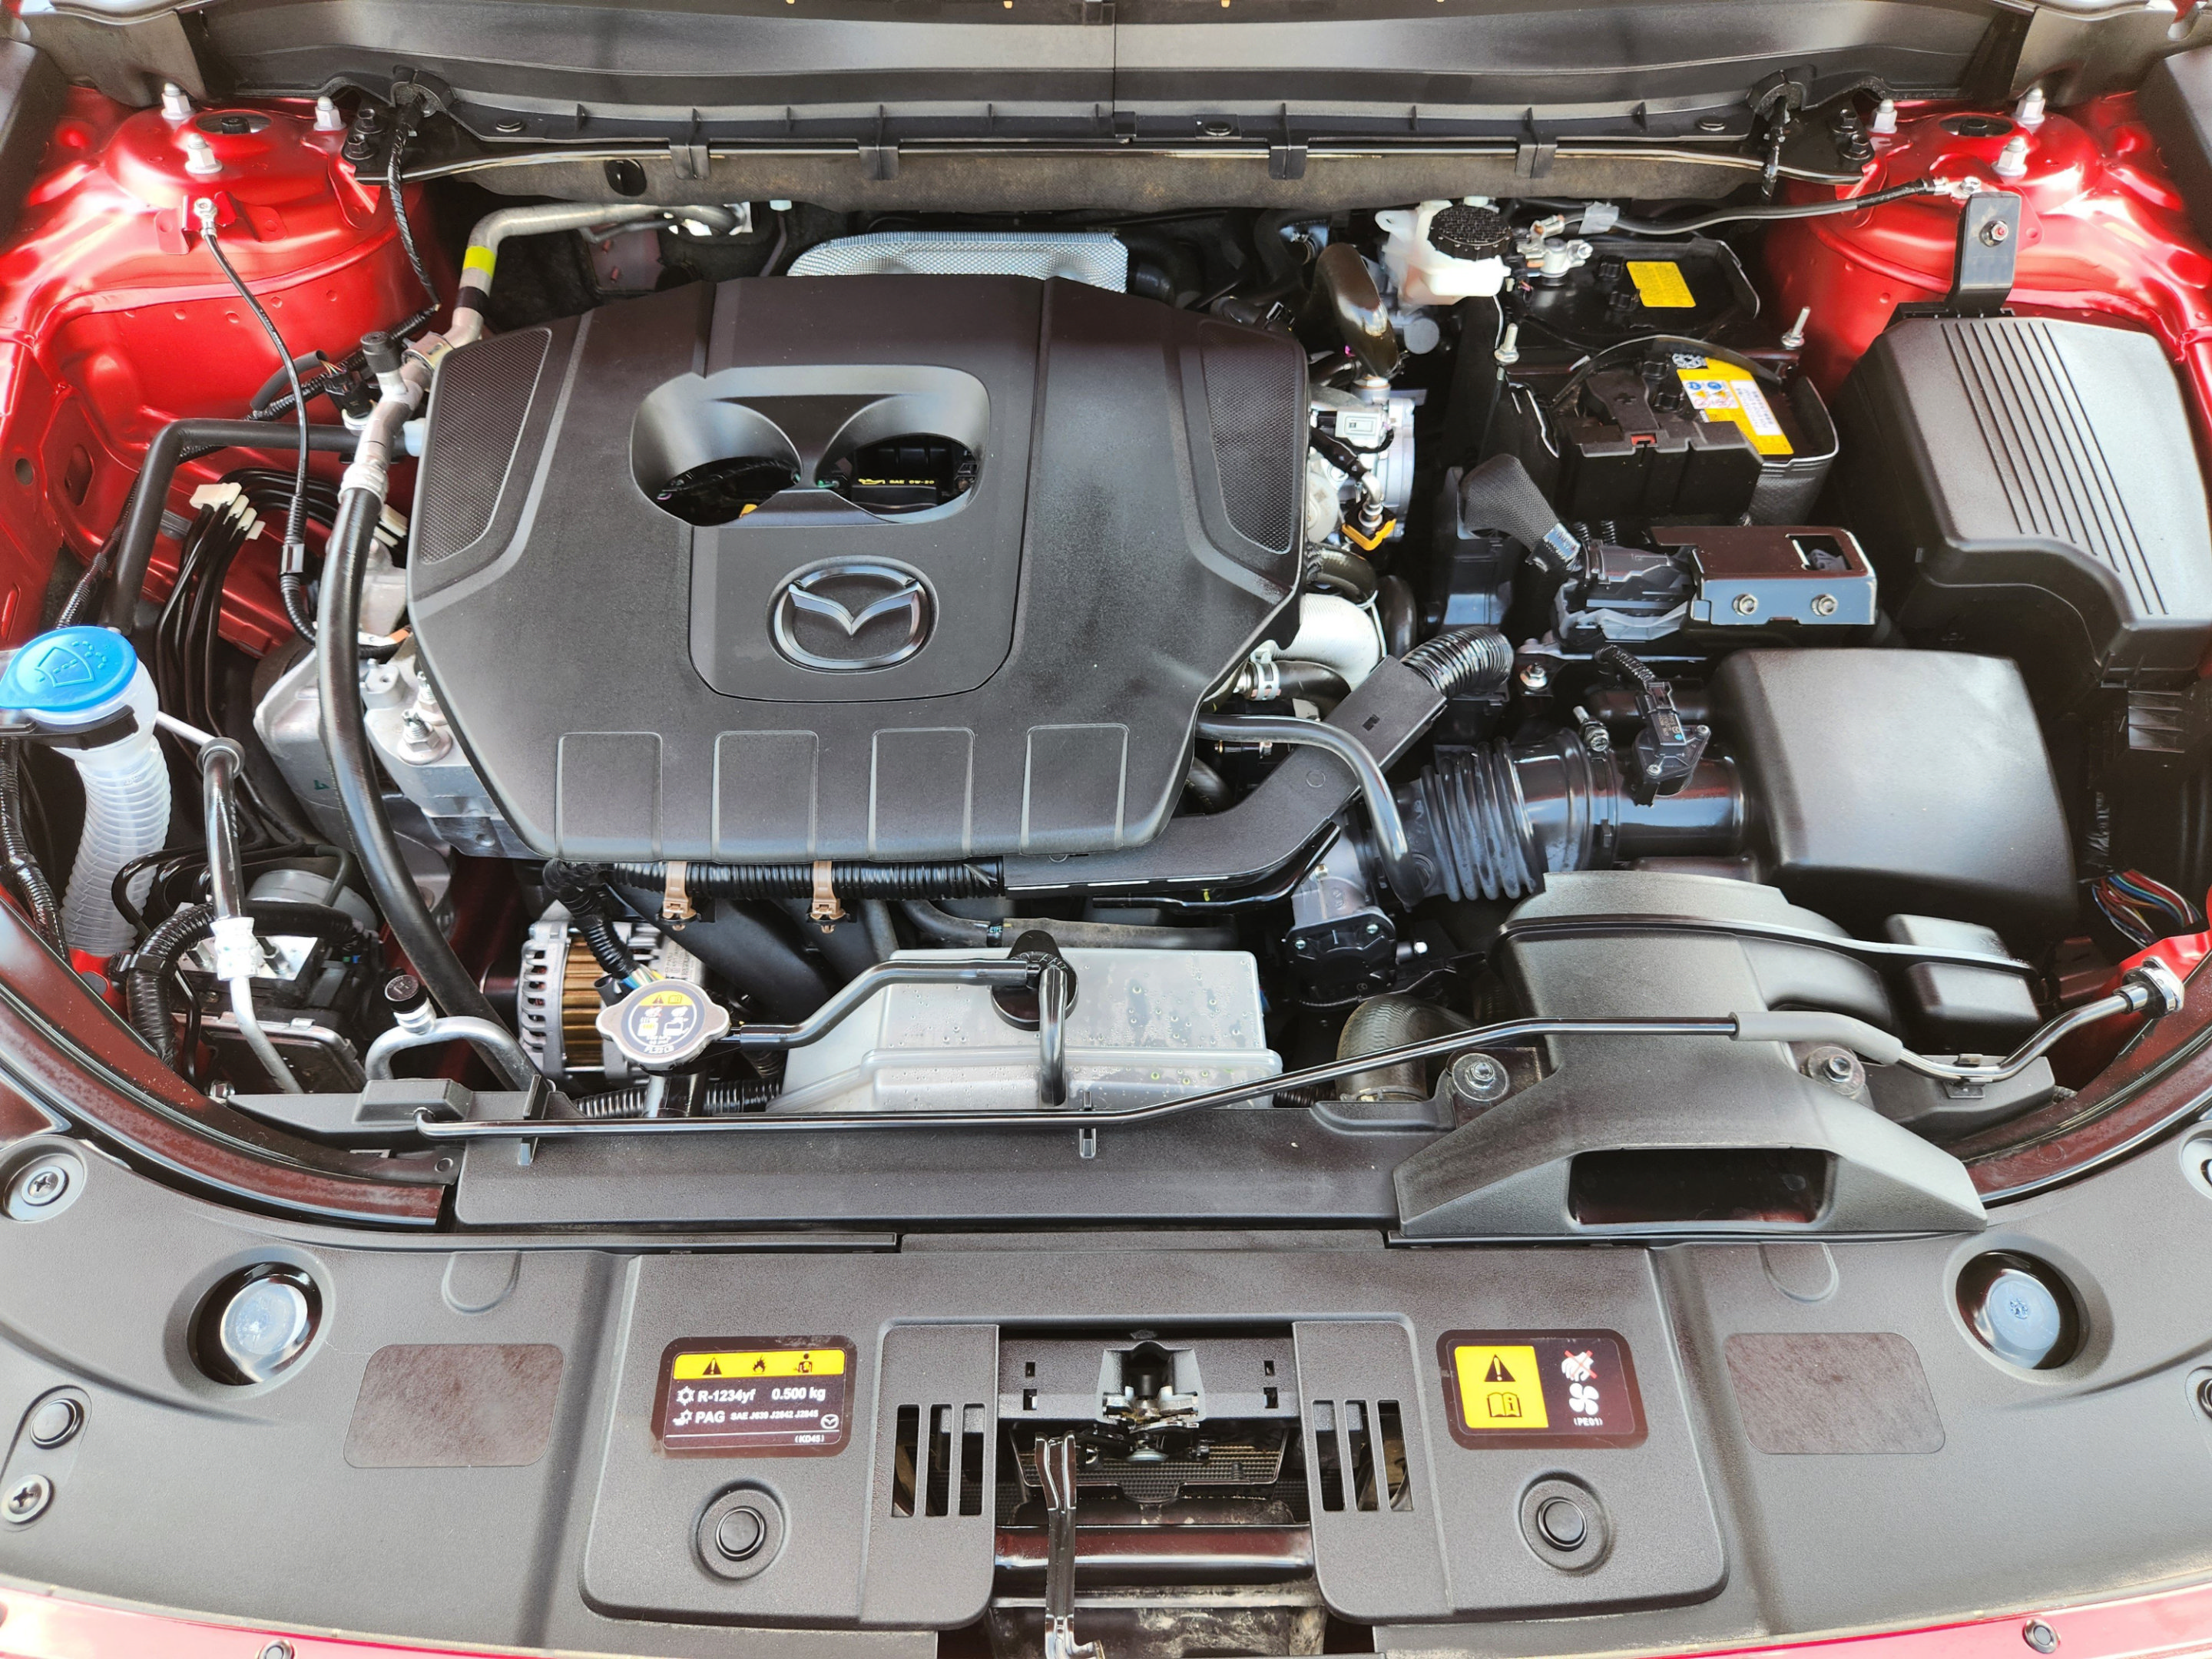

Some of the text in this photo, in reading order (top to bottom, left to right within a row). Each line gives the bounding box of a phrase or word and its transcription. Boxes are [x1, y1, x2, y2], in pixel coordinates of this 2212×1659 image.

[697, 1386, 826, 1404] R-1234yf 0.500 kg
[695, 1411, 725, 1423] PAG
[730, 1411, 748, 1421] SAE
